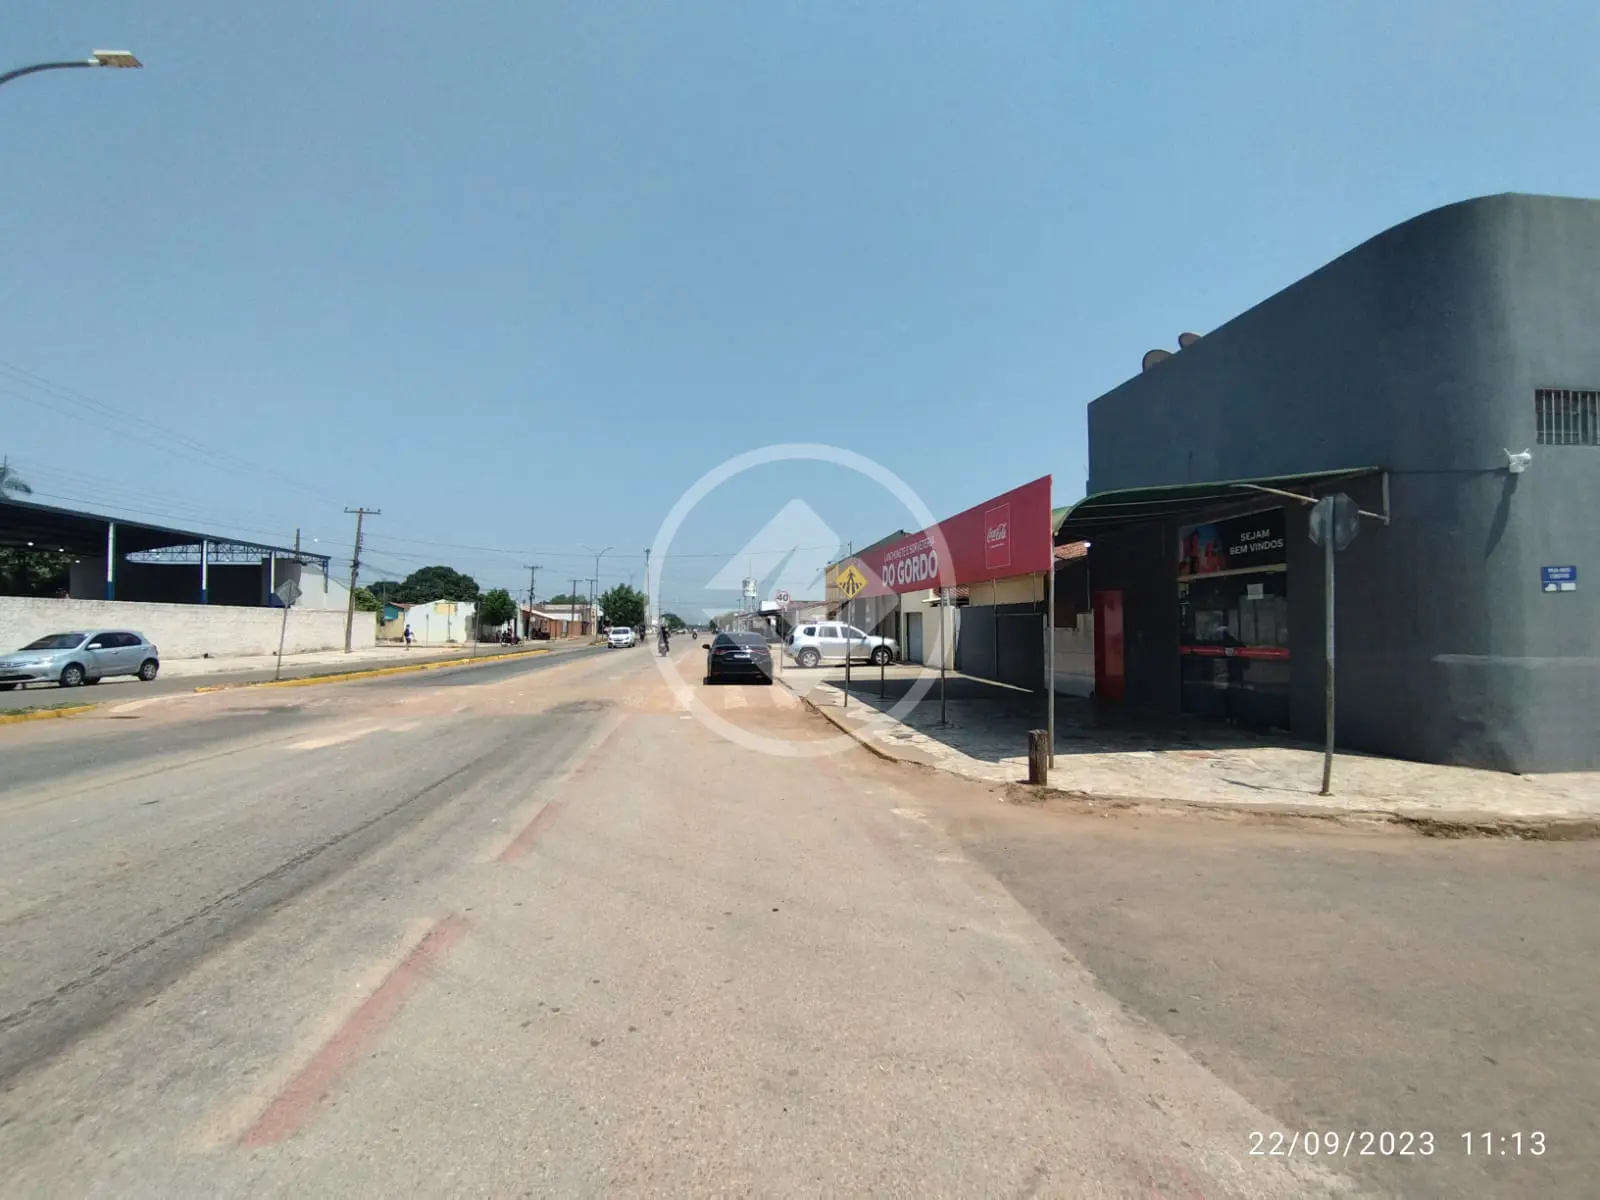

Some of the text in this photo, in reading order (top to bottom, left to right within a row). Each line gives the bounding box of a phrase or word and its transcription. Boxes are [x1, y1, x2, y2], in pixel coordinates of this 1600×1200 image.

[1240, 529, 1270, 541] SEJAM
[1229, 538, 1284, 555] BEM VINDOS
[882, 550, 938, 587] DO GORDO
[776, 594, 788, 602] 40
